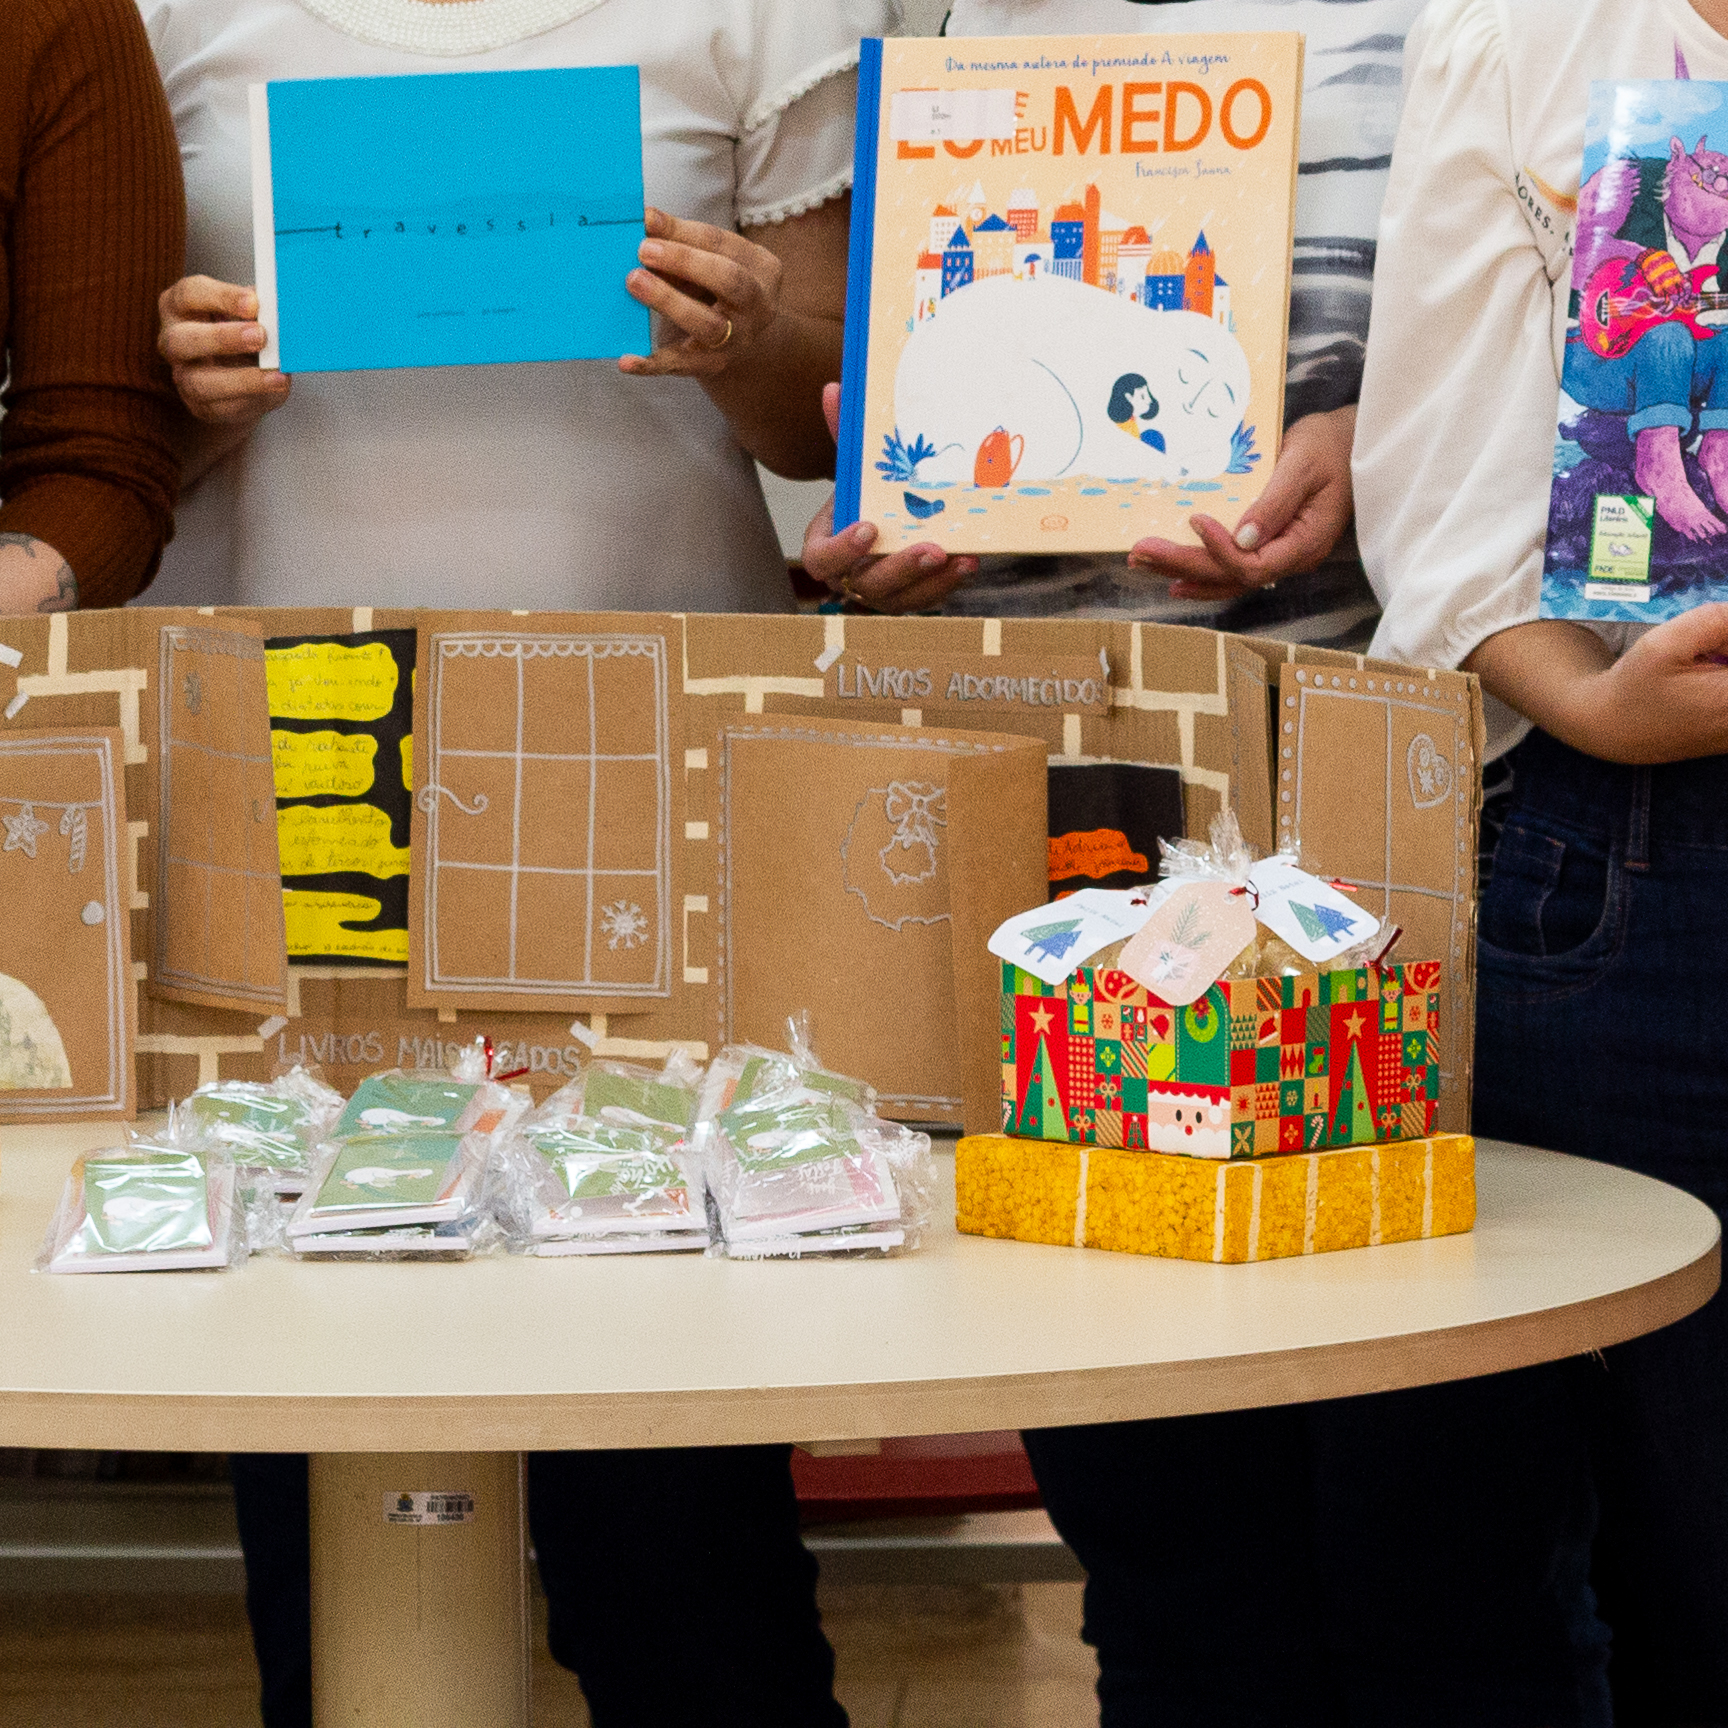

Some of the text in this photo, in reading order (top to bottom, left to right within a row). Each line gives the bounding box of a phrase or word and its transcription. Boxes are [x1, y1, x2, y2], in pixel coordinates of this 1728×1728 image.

[1022, 56, 1067, 71] autora
[1091, 54, 1158, 77] premiado
[1177, 52, 1231, 75] viagem
[989, 125, 1048, 158] MEU
[1052, 77, 1273, 158] MEDO
[837, 663, 933, 700] LIVROS
[278, 1030, 385, 1068] LIVROS
